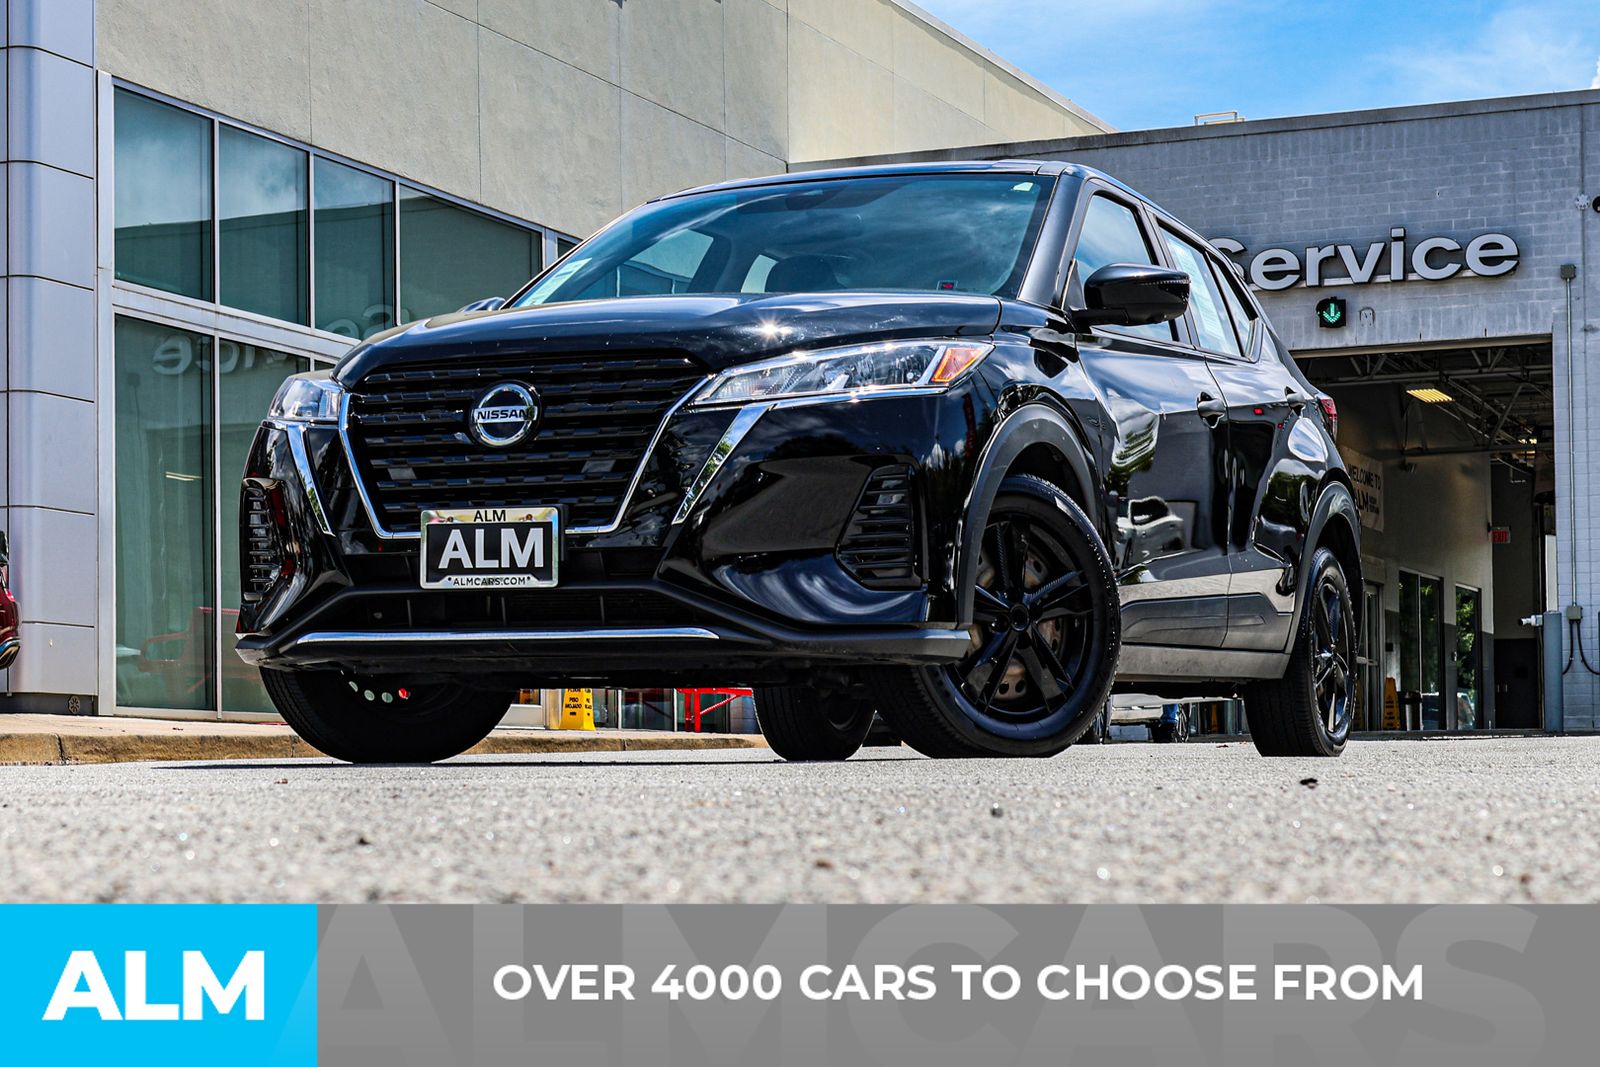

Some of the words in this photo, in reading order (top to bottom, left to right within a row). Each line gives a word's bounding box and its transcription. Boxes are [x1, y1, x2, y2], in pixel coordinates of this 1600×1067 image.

[477, 408, 530, 420] NISSAN
[473, 509, 506, 522] ALM
[438, 527, 544, 569] ALM
[452, 576, 526, 587] ALMCARS.COM
